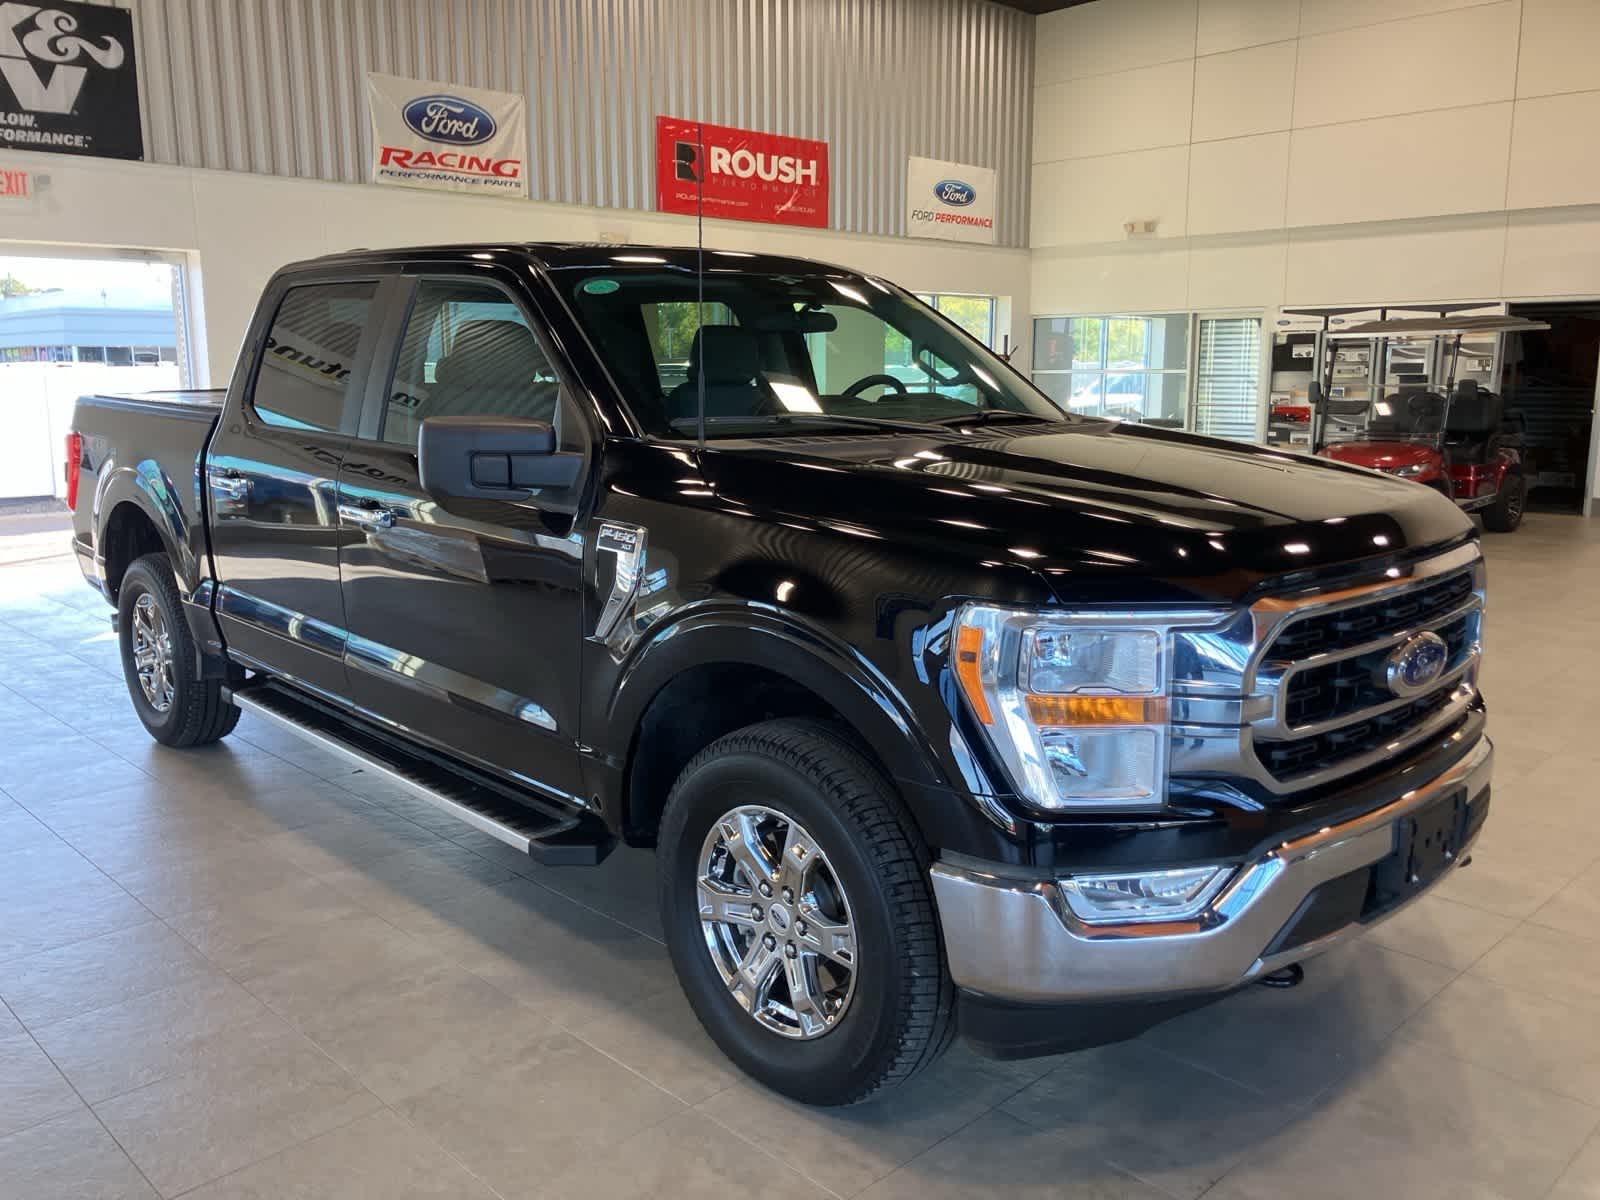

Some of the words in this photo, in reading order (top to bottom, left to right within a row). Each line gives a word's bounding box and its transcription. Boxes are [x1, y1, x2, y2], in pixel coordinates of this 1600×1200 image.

[421, 102, 479, 138] Ford
[380, 147, 521, 178] RACING
[710, 147, 817, 186] ROUSH
[380, 169, 481, 185] PERFORMANCE
[484, 178, 521, 188] PARTS
[942, 183, 968, 202] Ford
[911, 210, 934, 222] FORD
